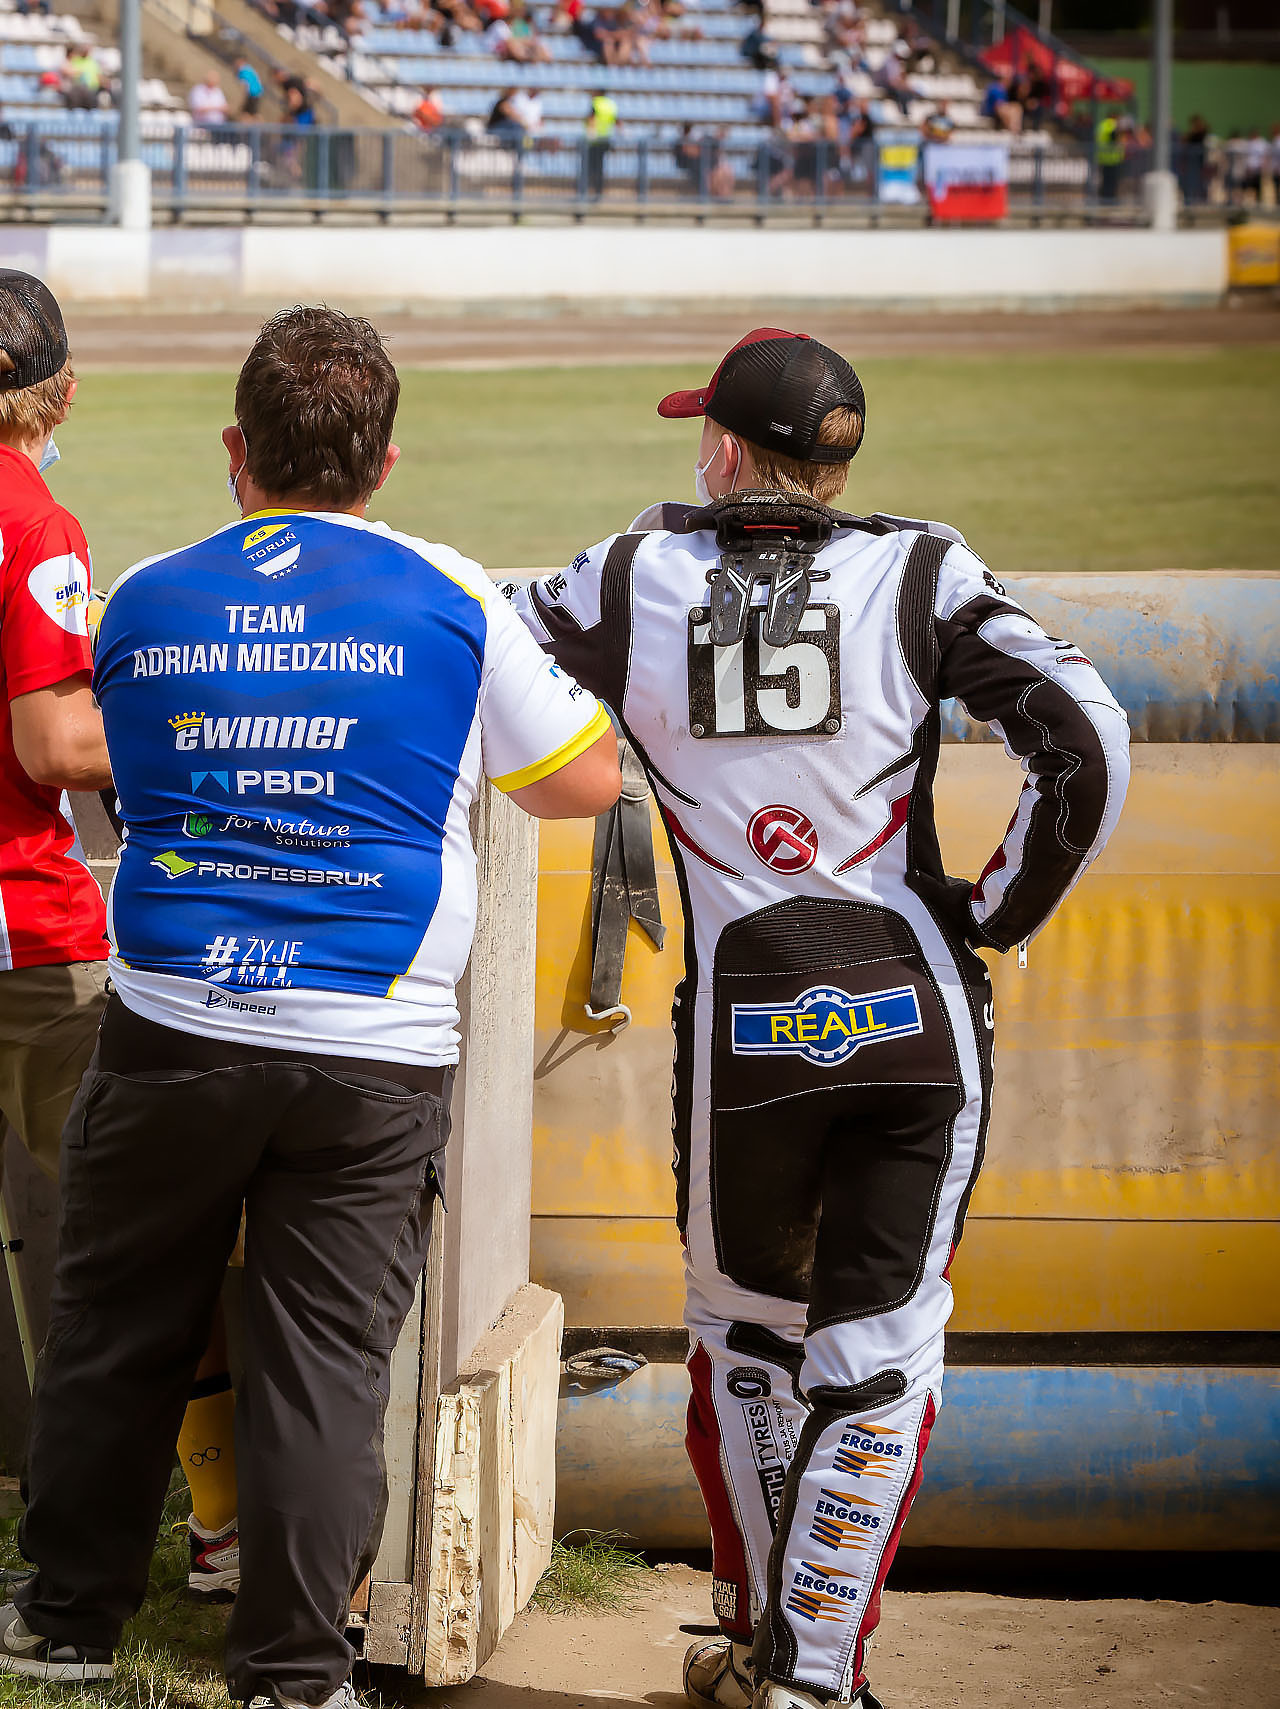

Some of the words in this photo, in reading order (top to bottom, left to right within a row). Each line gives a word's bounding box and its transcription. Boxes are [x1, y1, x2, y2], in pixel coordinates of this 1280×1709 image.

[246, 531, 297, 563] TORUŃ
[250, 530, 266, 542] KS
[224, 604, 306, 634] TEAM
[132, 643, 229, 679] ADRIAN
[236, 636, 405, 677] MIEDZIŃSKI
[693, 609, 831, 733] 15
[175, 716, 359, 751] ewinner
[236, 770, 335, 796] PBDI
[219, 814, 260, 832] for
[263, 816, 351, 837] Nature
[275, 835, 352, 849] Solutions
[197, 861, 386, 888] PROFESBRUK
[770, 1005, 887, 1043] REALL
[748, 1403, 776, 1466] TYRES
[839, 1433, 904, 1458] ERGOSS
[815, 1499, 881, 1529] ERGOSS
[793, 1571, 859, 1601] ERGOSS
